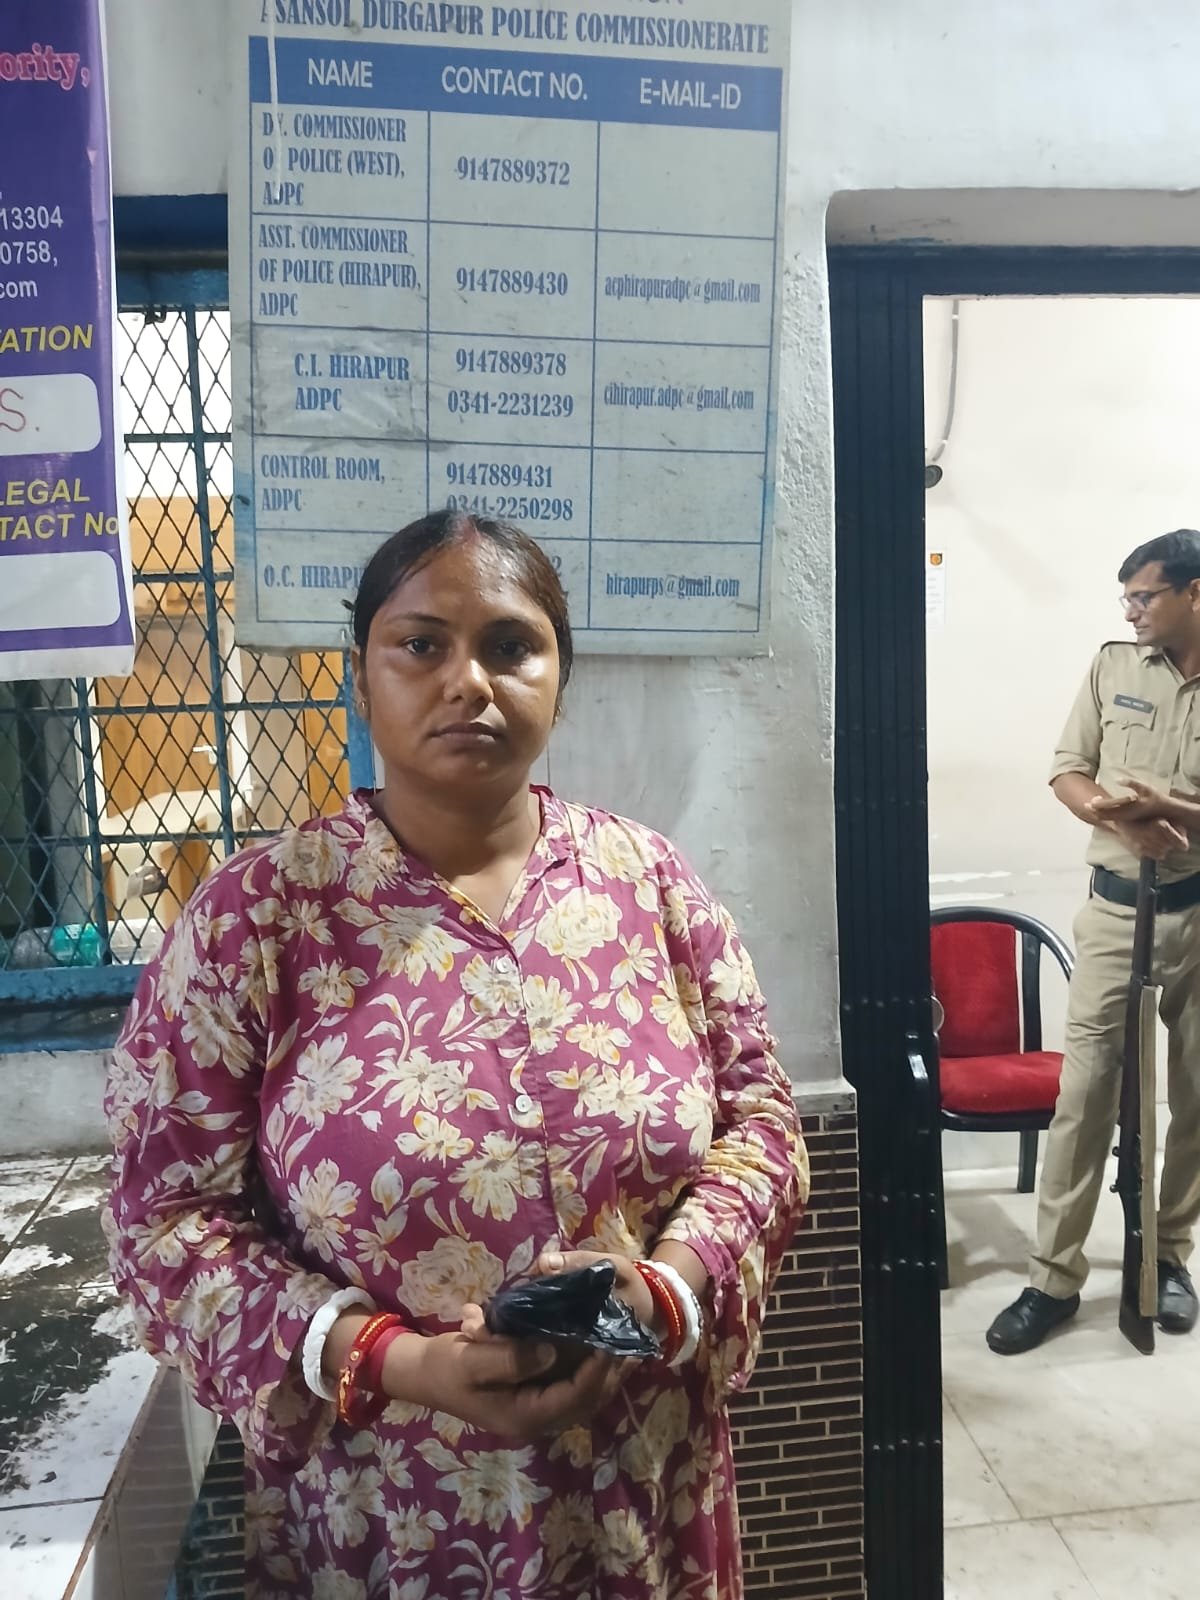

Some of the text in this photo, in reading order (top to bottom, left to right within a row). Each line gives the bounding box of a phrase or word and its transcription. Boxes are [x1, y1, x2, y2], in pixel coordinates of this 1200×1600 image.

[362, 0, 484, 37] DURGAPUR
[491, 7, 568, 41] POLICE
[576, 12, 769, 54] COMMISSIONERATE
[308, 58, 374, 89] NAME
[441, 65, 588, 101] CONTACT NO.
[640, 78, 741, 110] E-MAIL-ID
[294, 113, 407, 142] COMMISSIONER
[288, 147, 343, 174] POLICE
[347, 150, 405, 178] (WEST),
[457, 156, 570, 185] 9147889372
[258, 223, 409, 254] ASST. COMMISSIONER
[258, 257, 421, 290] OF POLICE (HIRAPUR),
[456, 267, 568, 296] 9147889430
[259, 292, 298, 317] ADPC
[0, 324, 93, 353] ATION
[294, 352, 410, 381] C.I. HIRAPUR
[456, 348, 567, 376] 9147889378
[295, 386, 342, 412] ADPC
[448, 390, 574, 418] 0341-2231239
[261, 454, 385, 484] CONTROL ROOM,
[446, 462, 552, 488] 9147889431
[0, 478, 90, 506] EGAL
[262, 487, 302, 511] ADPC
[446, 495, 573, 520] 0341-2250298
[263, 564, 295, 588] O.C.
[606, 573, 740, 599] hirapurps@gmail.com
